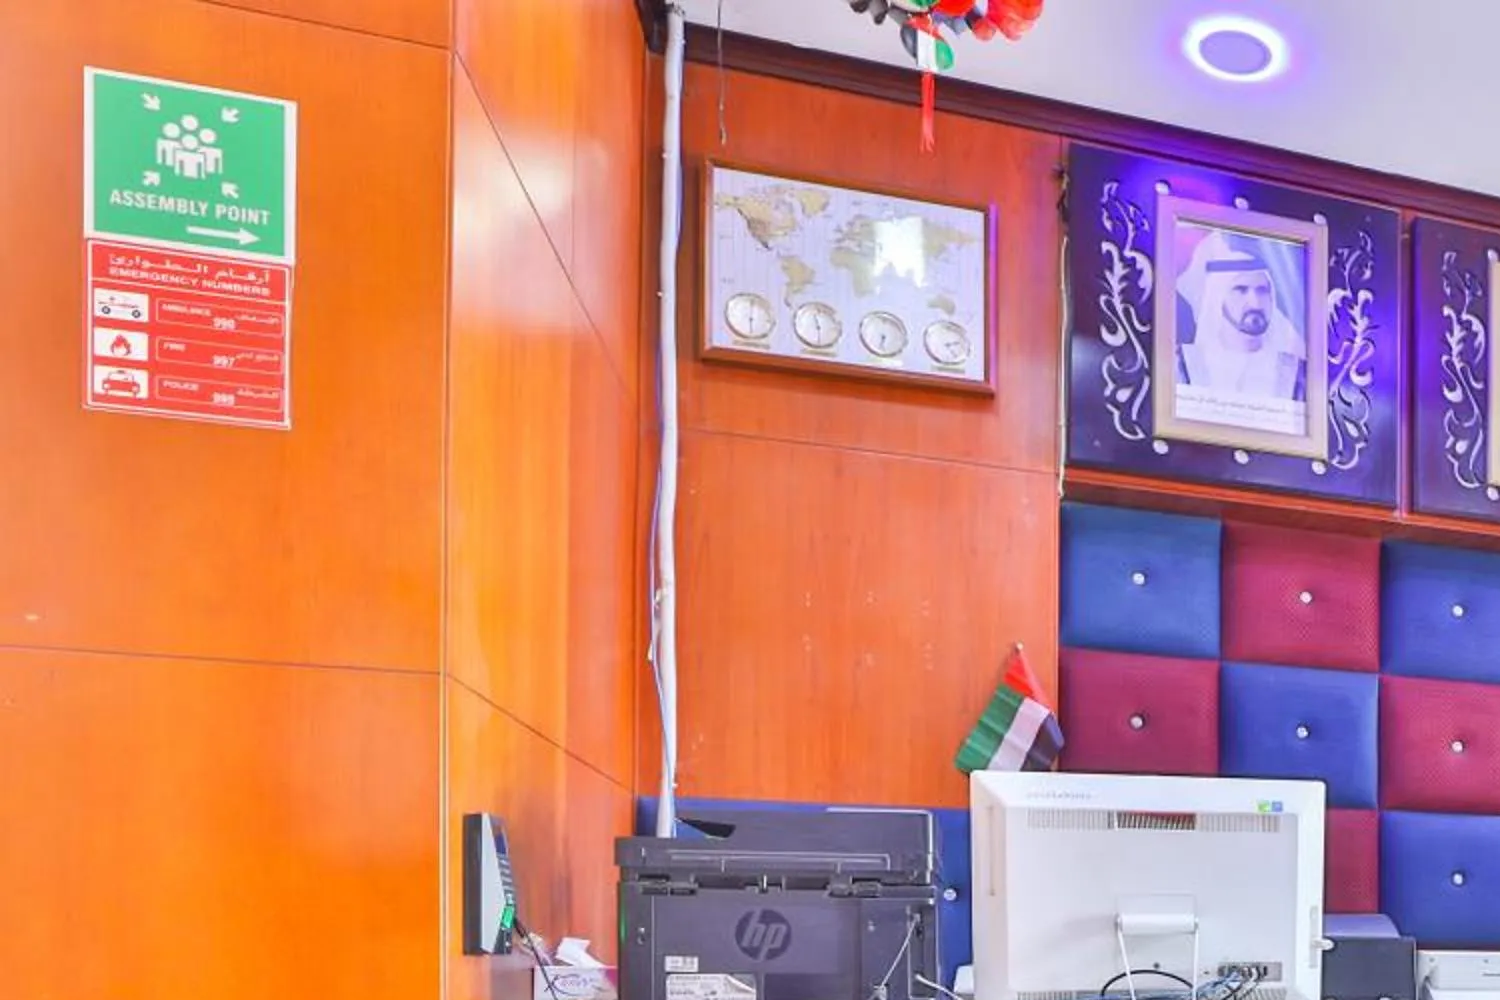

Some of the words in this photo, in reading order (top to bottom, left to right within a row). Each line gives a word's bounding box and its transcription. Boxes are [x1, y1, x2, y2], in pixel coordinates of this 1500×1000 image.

[109, 189, 207, 218] ASSEMBLY
[215, 204, 271, 226] POINT
[108, 267, 199, 288] EMERGENCY
[201, 279, 271, 297] NUMBERS
[739, 907, 789, 962] hp
